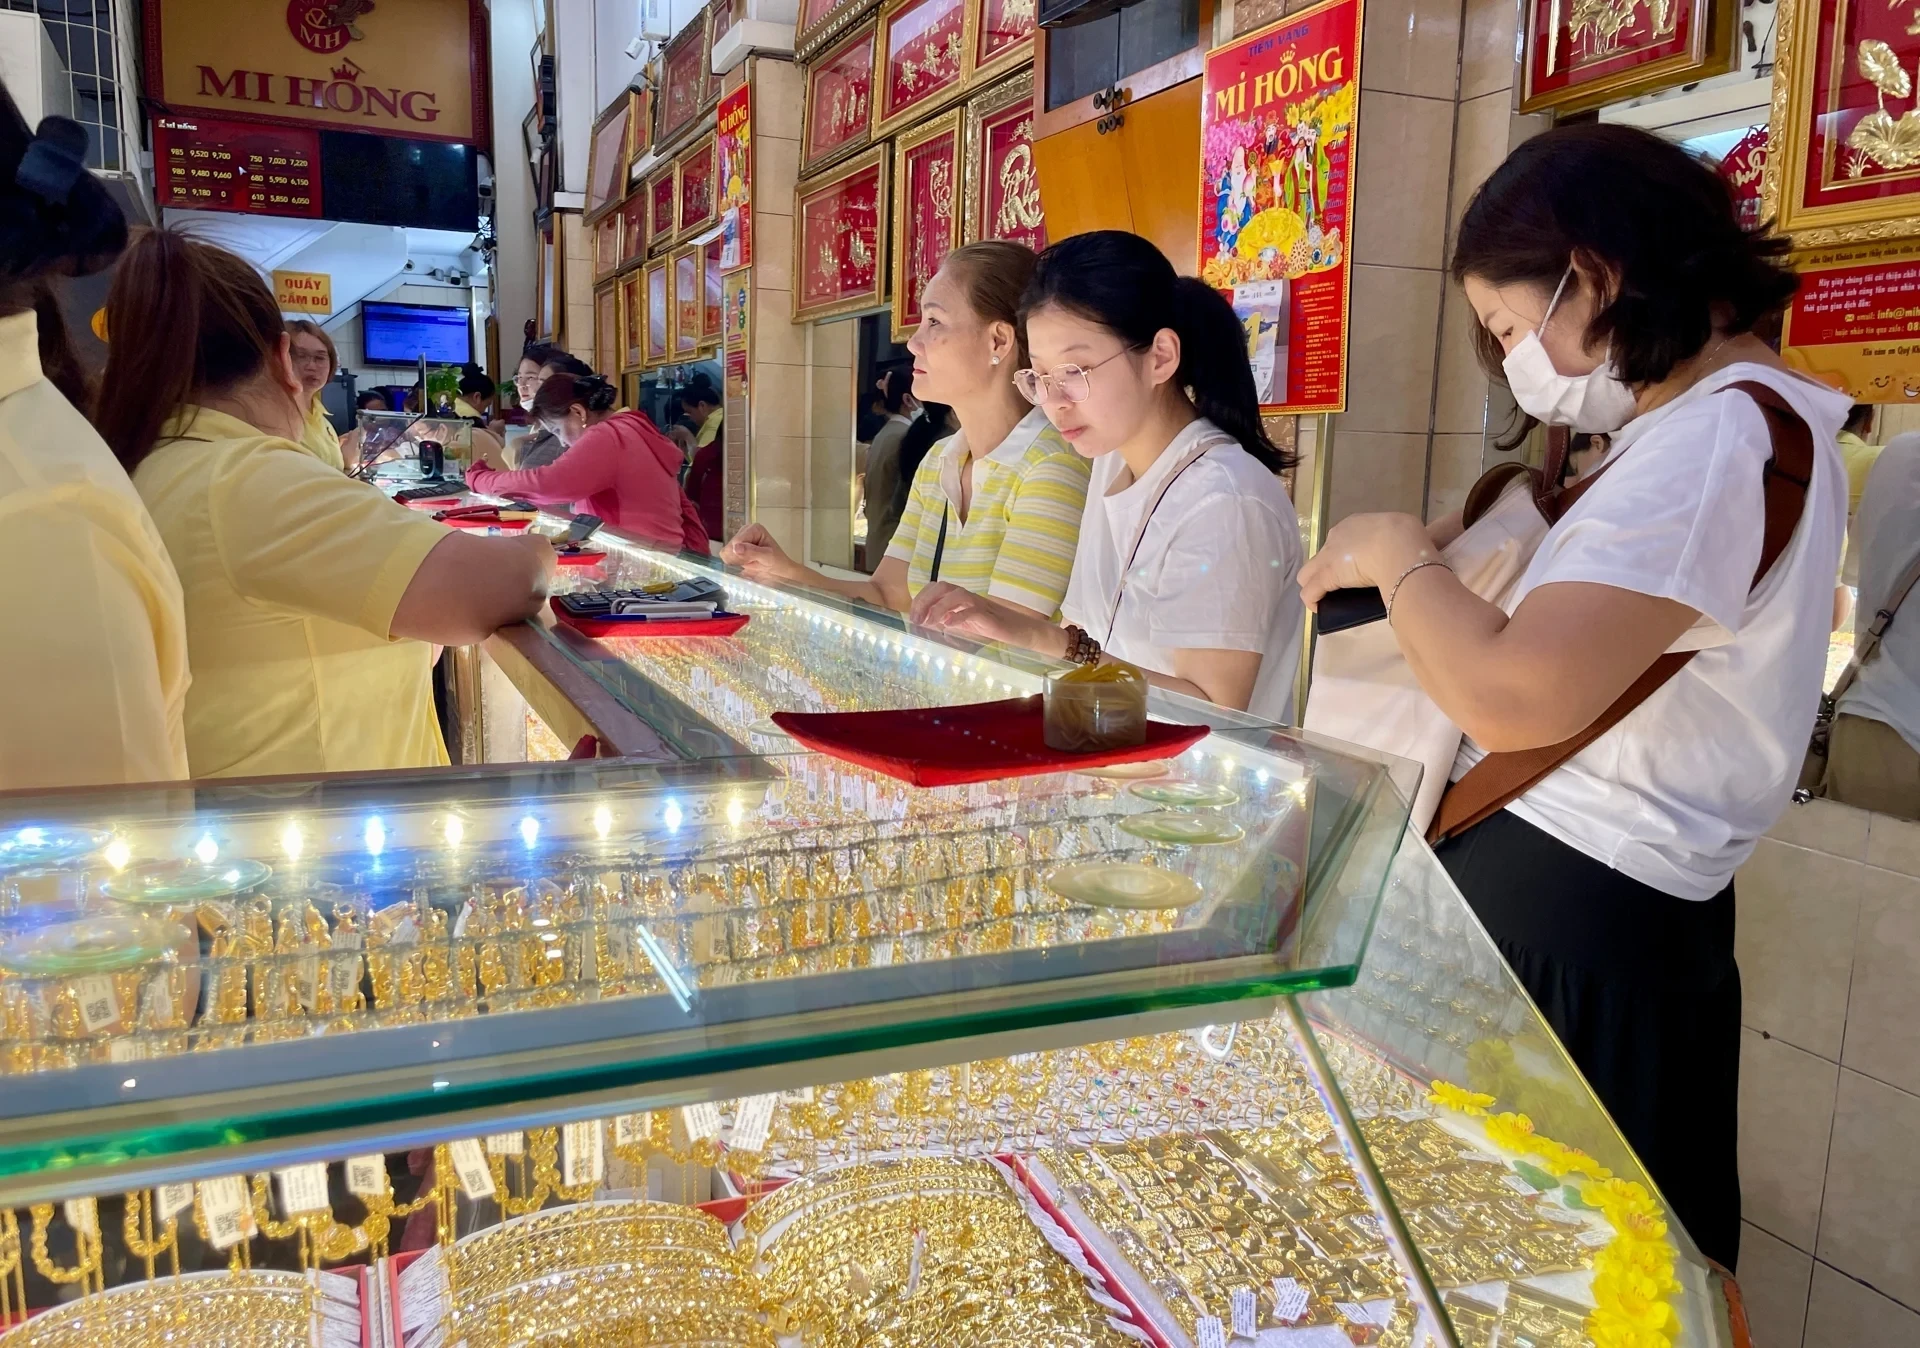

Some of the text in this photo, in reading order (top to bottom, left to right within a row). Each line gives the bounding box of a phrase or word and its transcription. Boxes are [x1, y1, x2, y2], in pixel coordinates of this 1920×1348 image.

[300, 23, 341, 49] MH
[285, 57, 441, 122] HỒNG
[170, 148, 231, 160] 985 9,520 9,700
[250, 155, 308, 167] 750 7,020 7,220
[171, 167, 232, 180] 980 9,480 9,660
[250, 174, 309, 186] 680 5,950 6,150
[173, 187, 187, 195] 950
[192, 188, 211, 197] 9,180
[251, 193, 310, 205] 610 5,850 6,050
